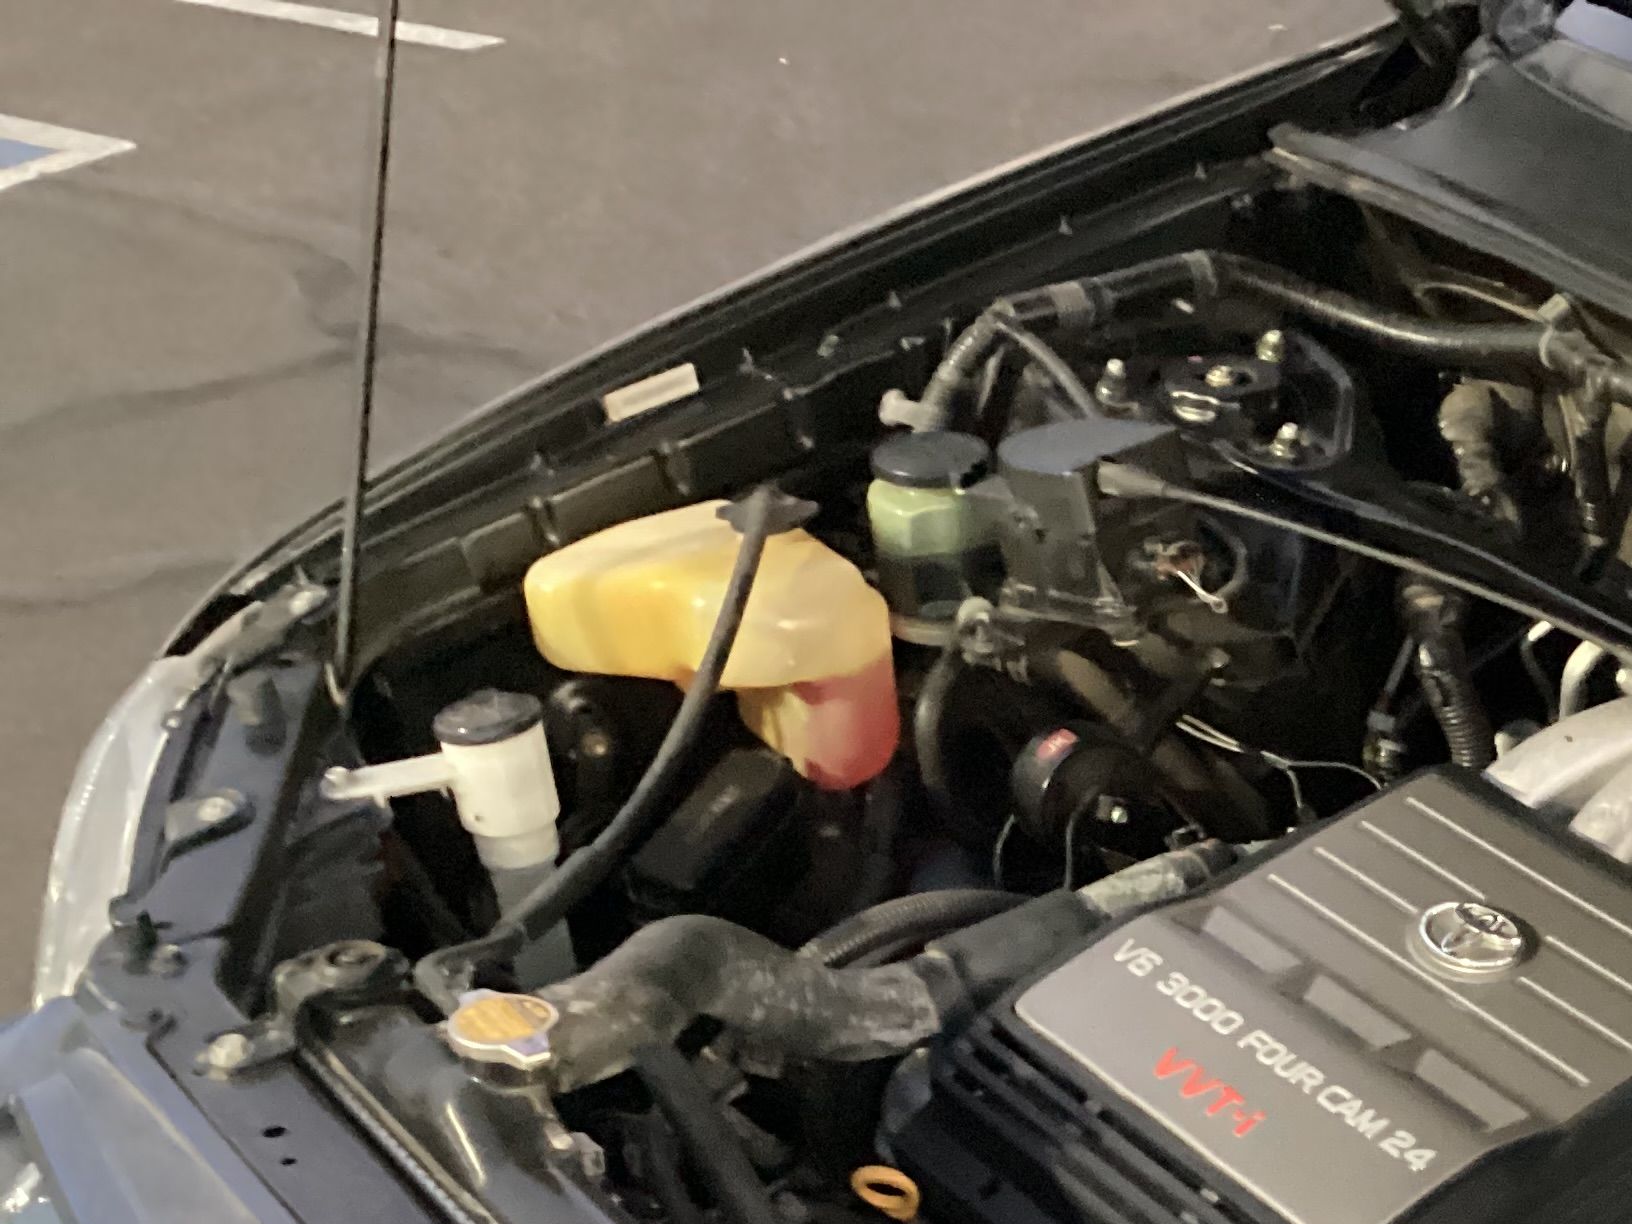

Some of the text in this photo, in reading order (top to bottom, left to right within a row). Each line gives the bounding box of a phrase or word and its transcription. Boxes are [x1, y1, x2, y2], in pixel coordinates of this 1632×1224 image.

[1113, 936, 1438, 1174] V6 3000 FOUR CAM 24
[1152, 1046, 1267, 1139] VVT-i
